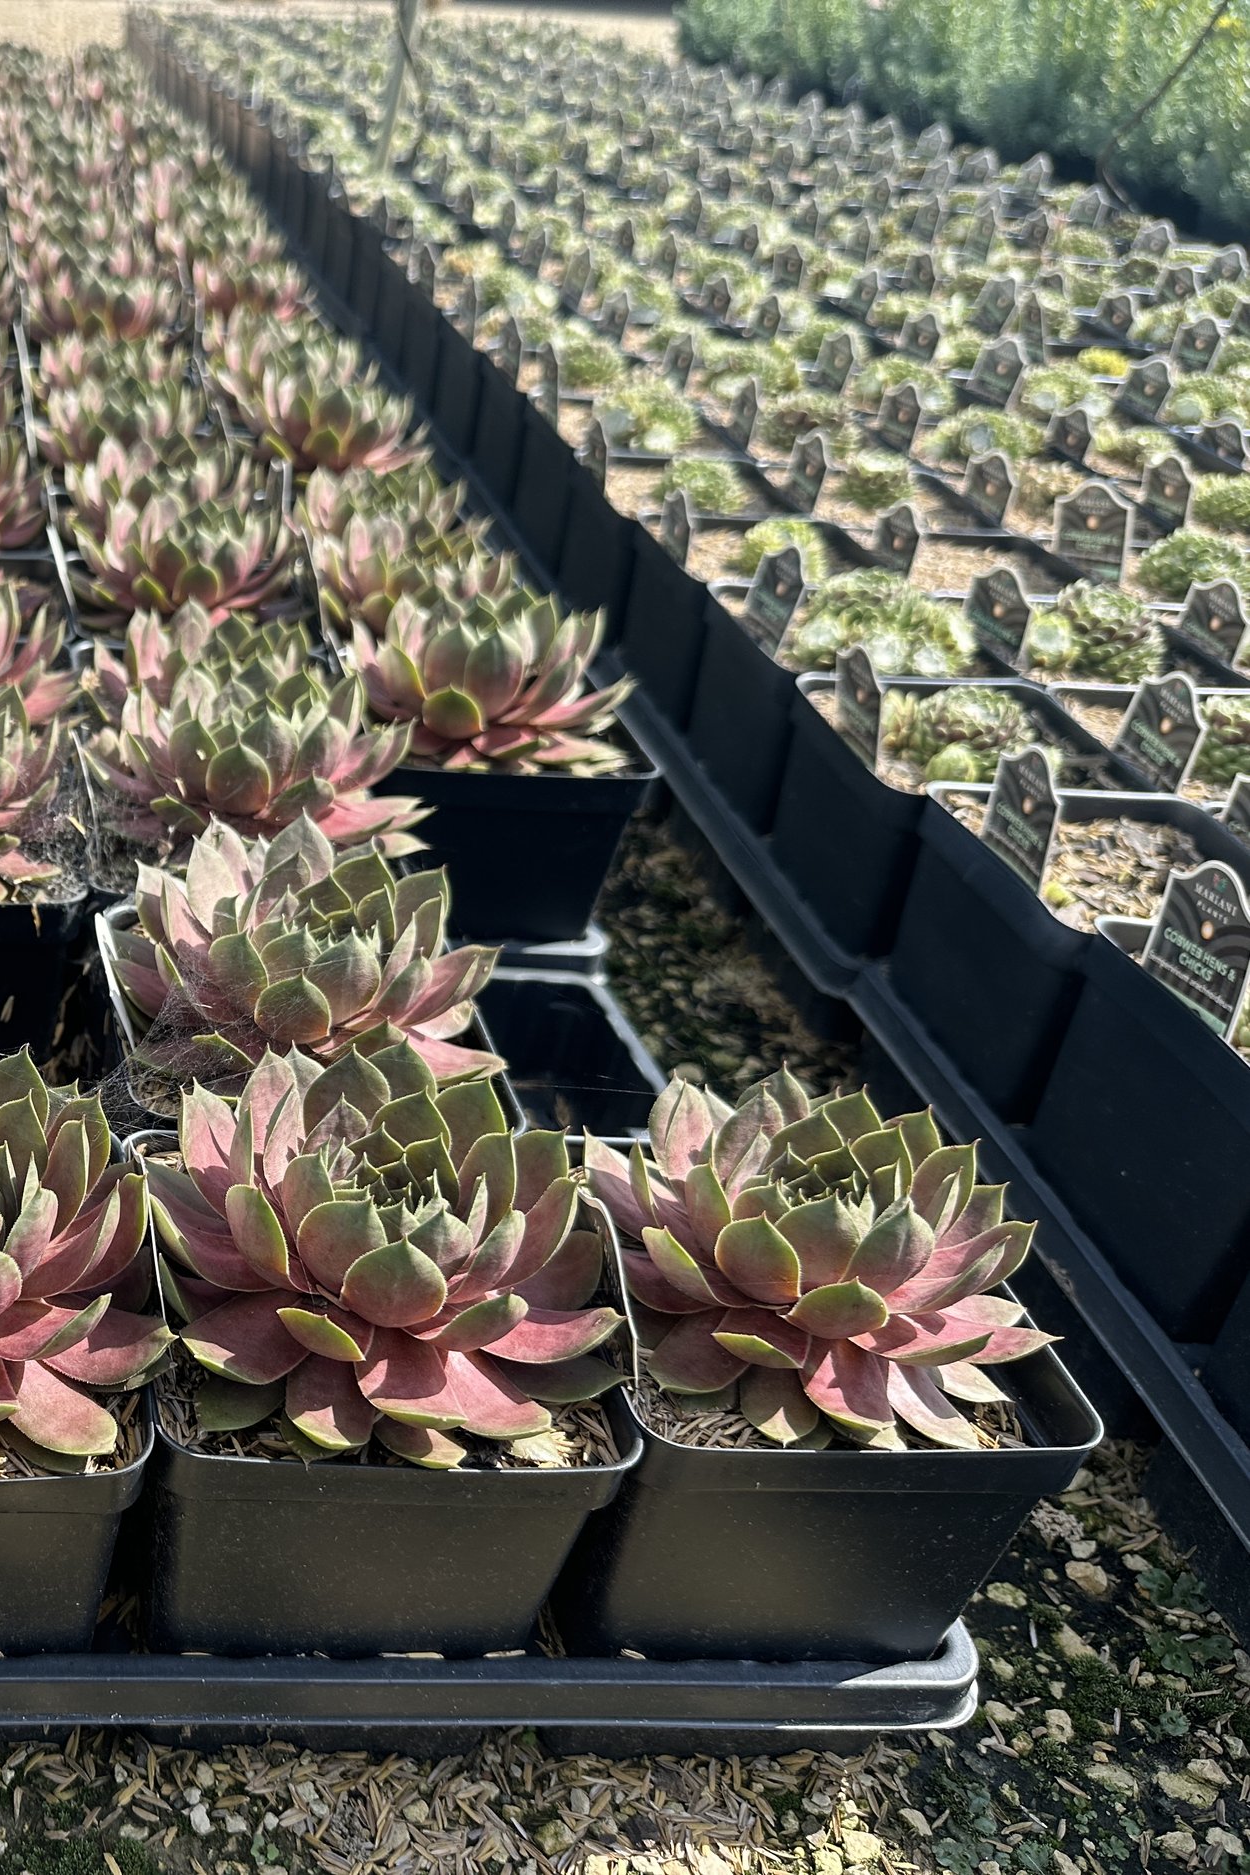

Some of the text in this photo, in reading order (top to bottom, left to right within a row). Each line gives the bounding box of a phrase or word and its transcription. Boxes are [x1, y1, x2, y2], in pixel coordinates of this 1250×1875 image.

[1195, 882, 1238, 917] MARIANI
[1196, 900, 1229, 925] PLANTS
[1164, 926, 1237, 982] COBWEB HENS &
[1178, 952, 1214, 981] CHICKS
